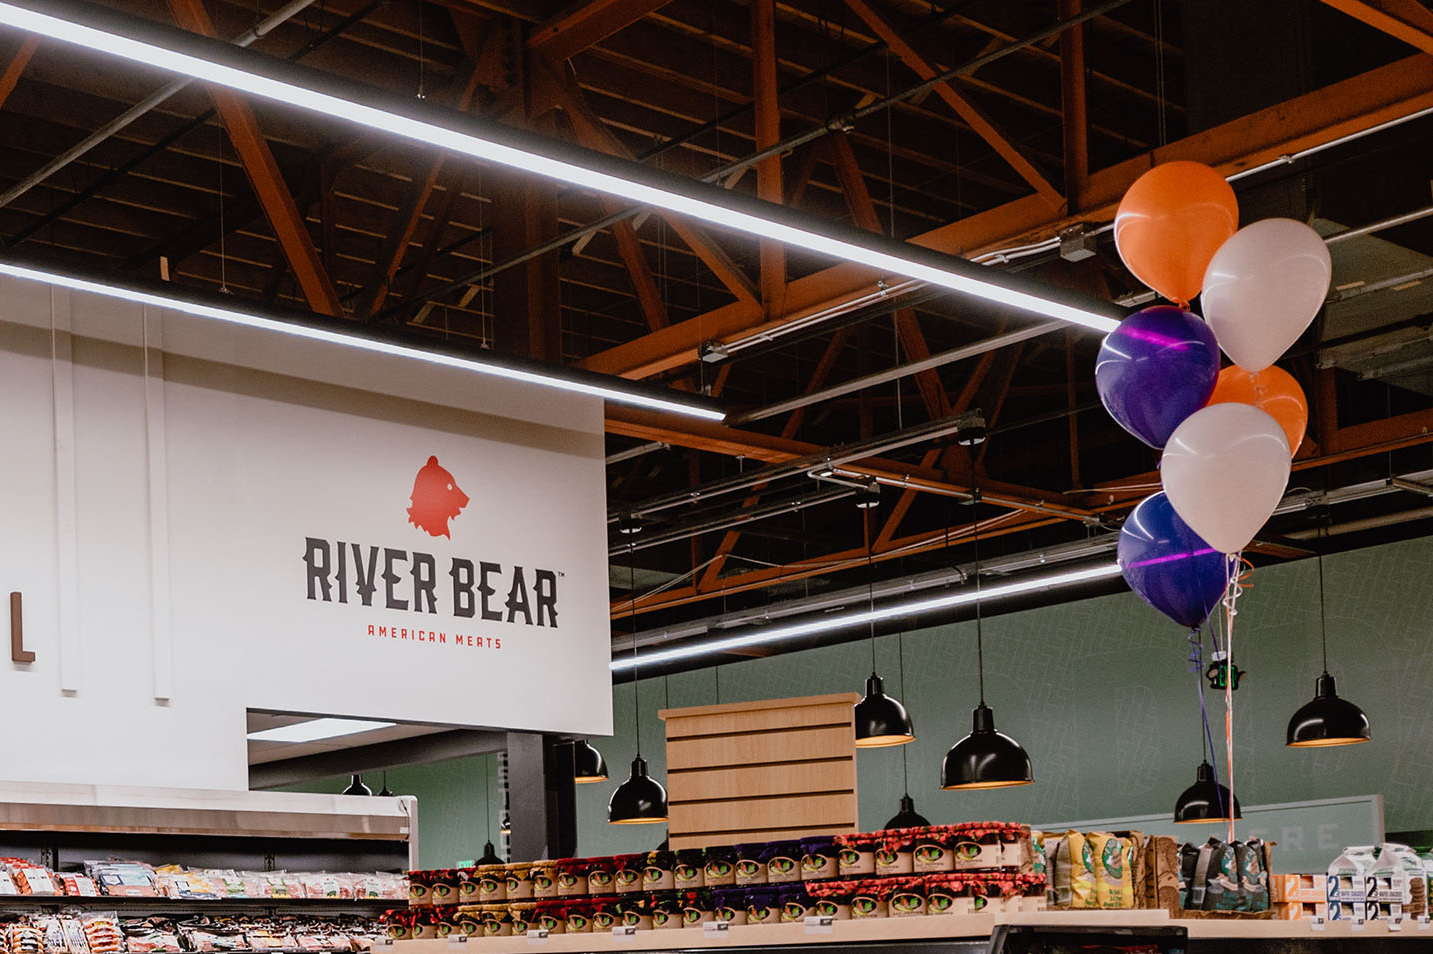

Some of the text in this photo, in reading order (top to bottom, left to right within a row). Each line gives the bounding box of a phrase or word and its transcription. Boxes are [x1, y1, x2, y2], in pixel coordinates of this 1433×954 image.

[302, 537, 437, 615] RIVER
[449, 557, 559, 628] BEAR
[368, 624, 502, 650] AMERICAN MEATS
